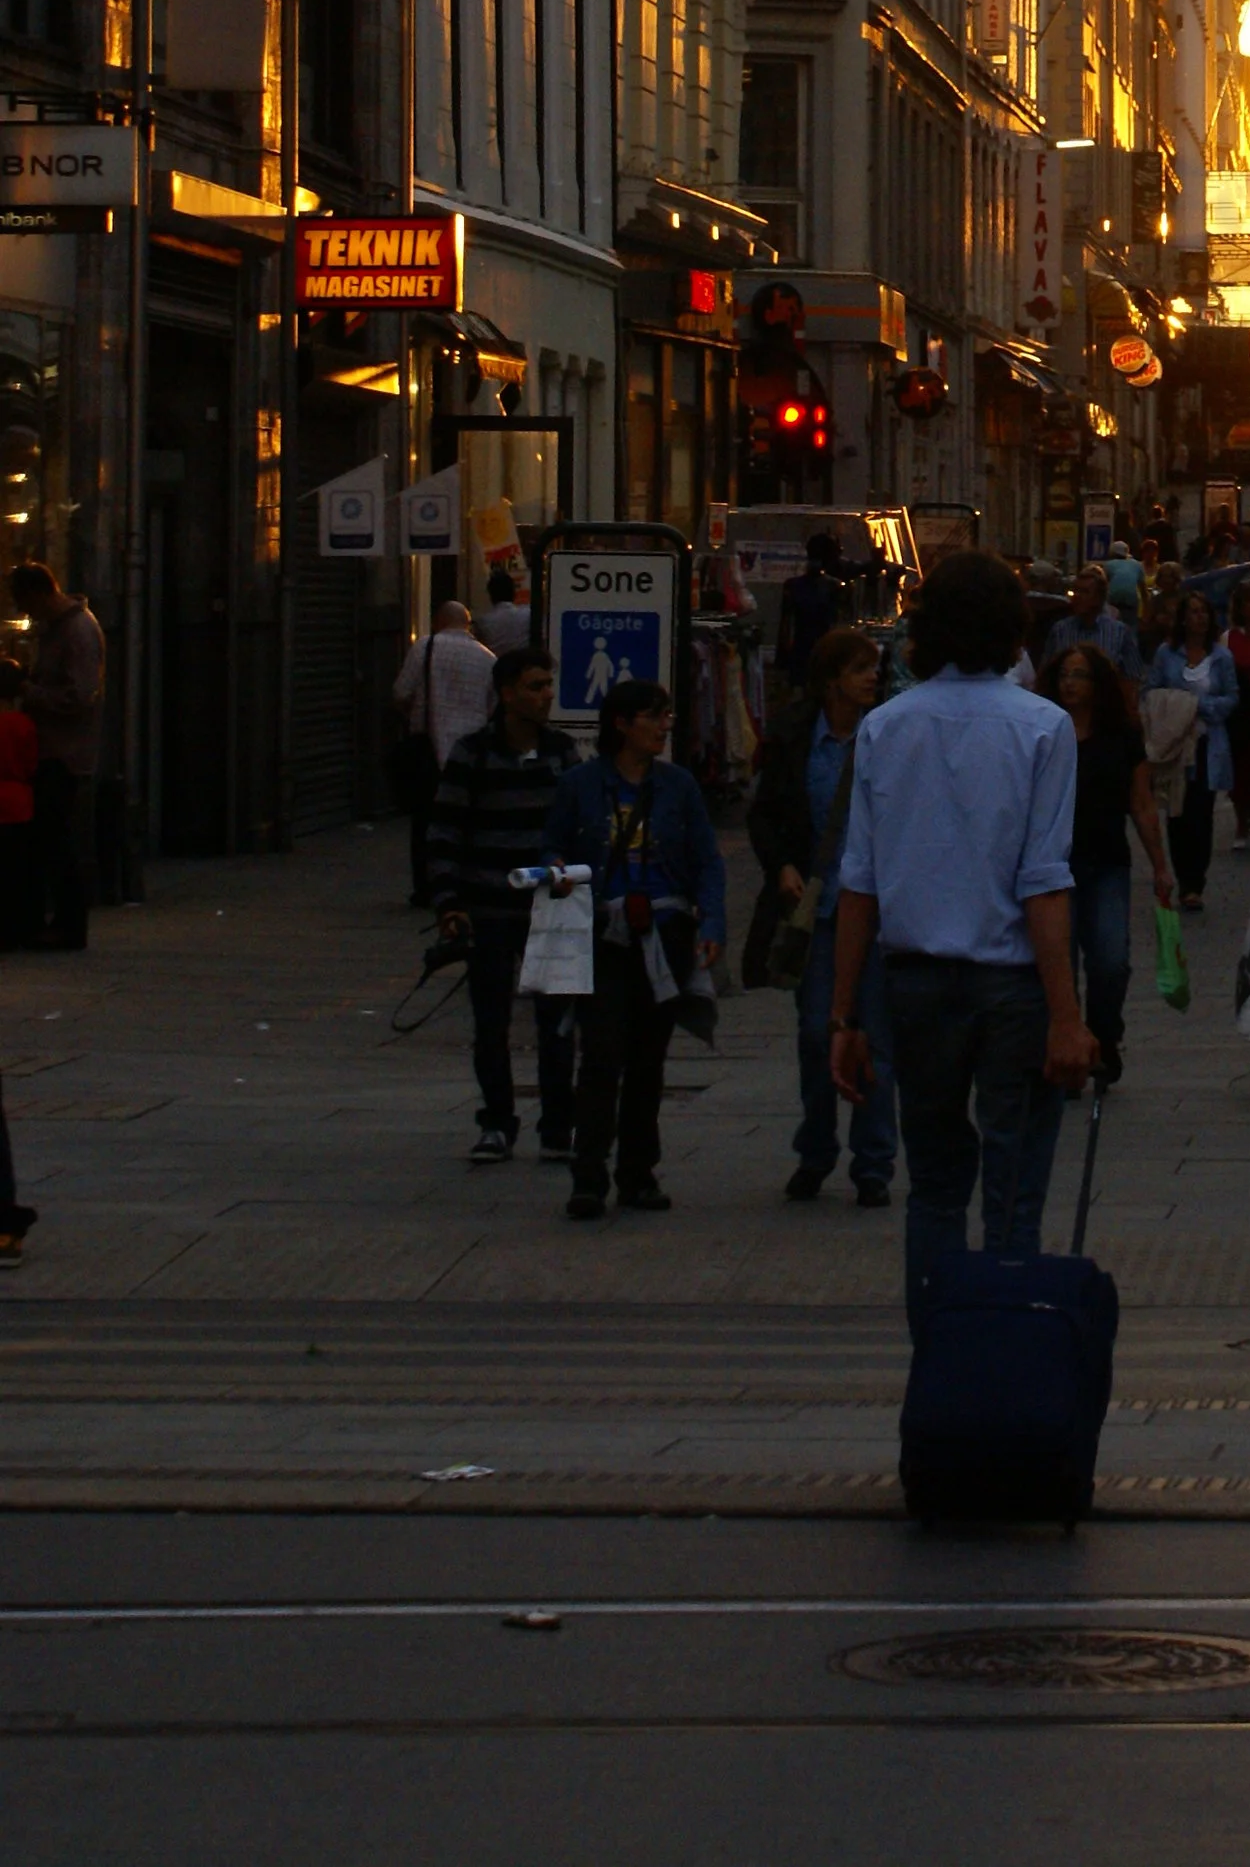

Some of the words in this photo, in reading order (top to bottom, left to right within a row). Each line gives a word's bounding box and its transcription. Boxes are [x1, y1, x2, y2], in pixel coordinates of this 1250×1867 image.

[30, 154, 104, 177] NOR
[1033, 153, 1048, 292] FLAVA
[303, 229, 443, 267] TEKNIK
[304, 275, 445, 299] MAGASINET
[570, 563, 654, 593] Sone
